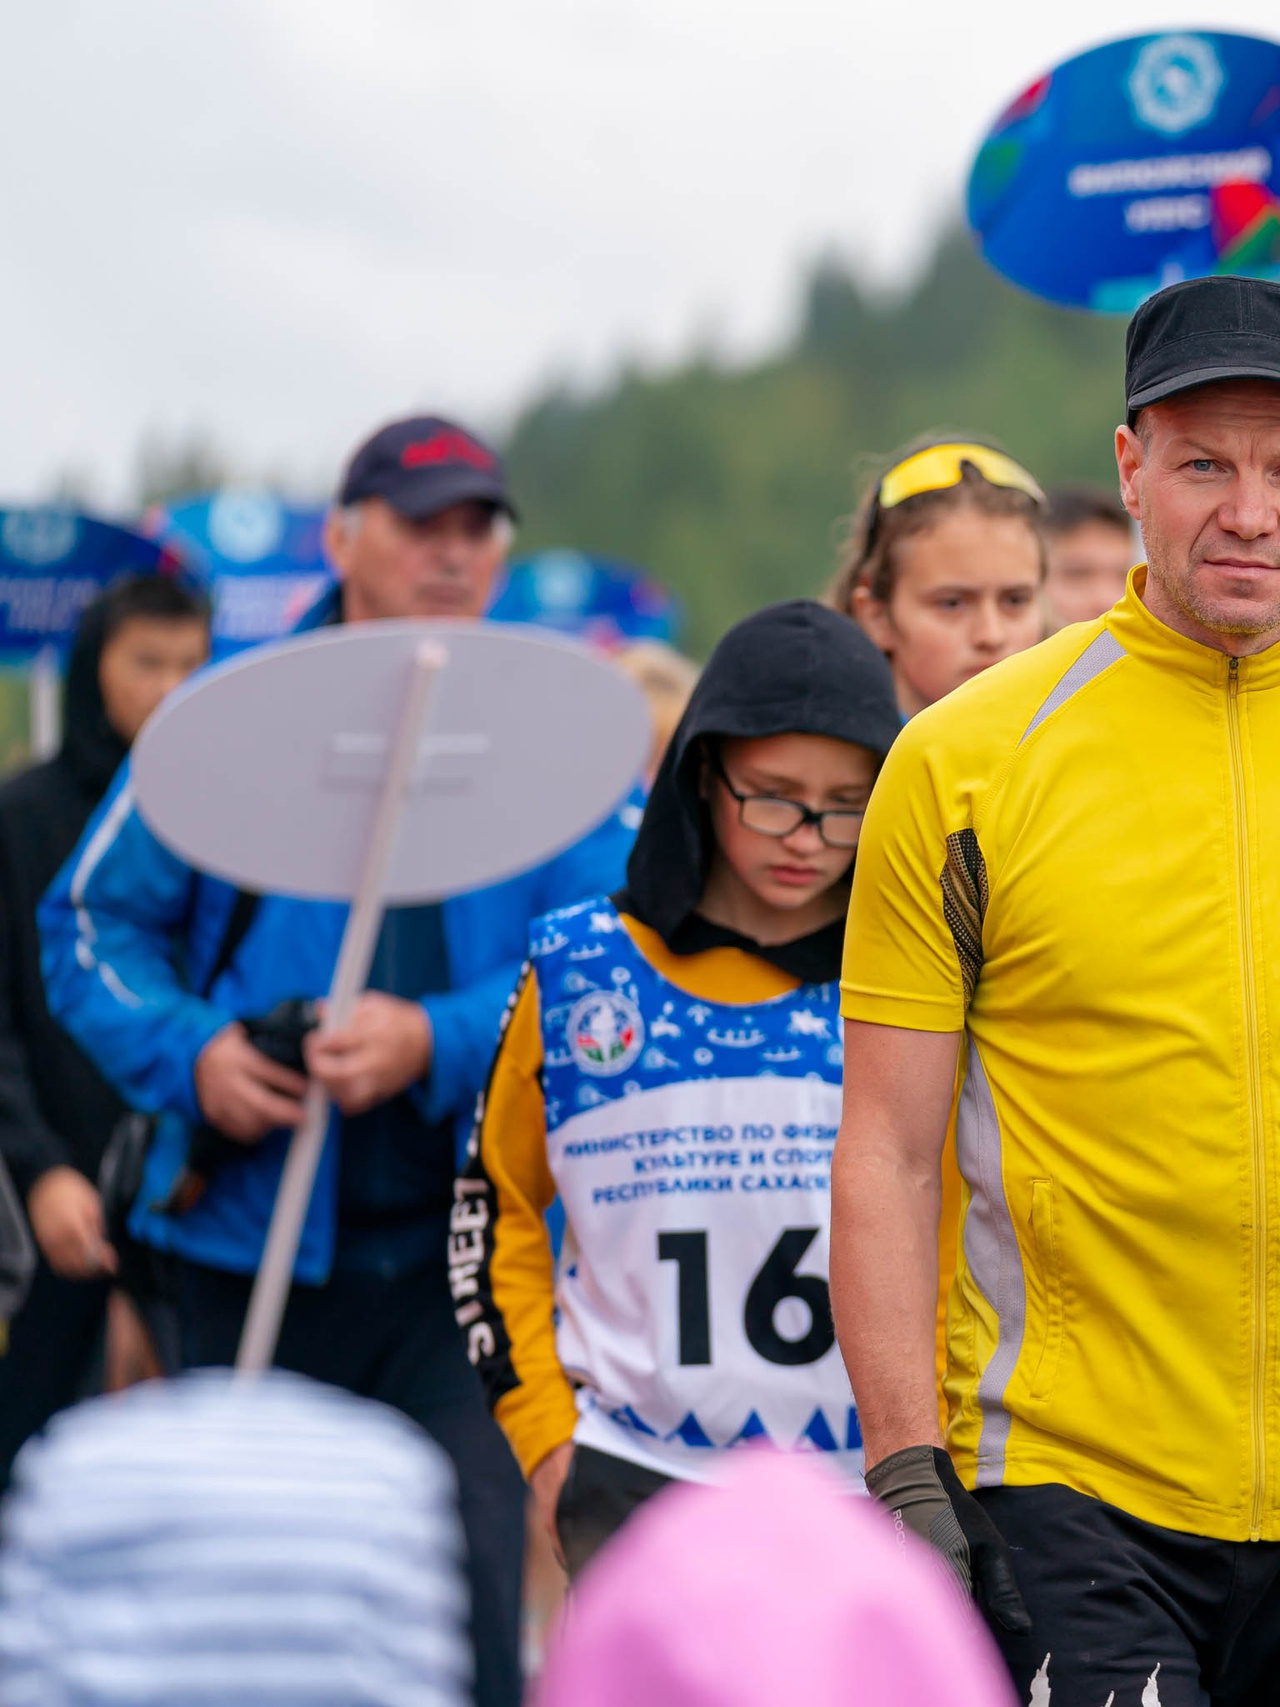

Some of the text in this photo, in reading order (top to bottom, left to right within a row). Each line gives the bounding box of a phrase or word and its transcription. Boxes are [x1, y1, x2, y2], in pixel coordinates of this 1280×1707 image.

[742, 1123, 774, 1142] ПО
[782, 1122, 840, 1141] ФИЗИ
[749, 1149, 765, 1166] И
[657, 1226, 836, 1366] 16
